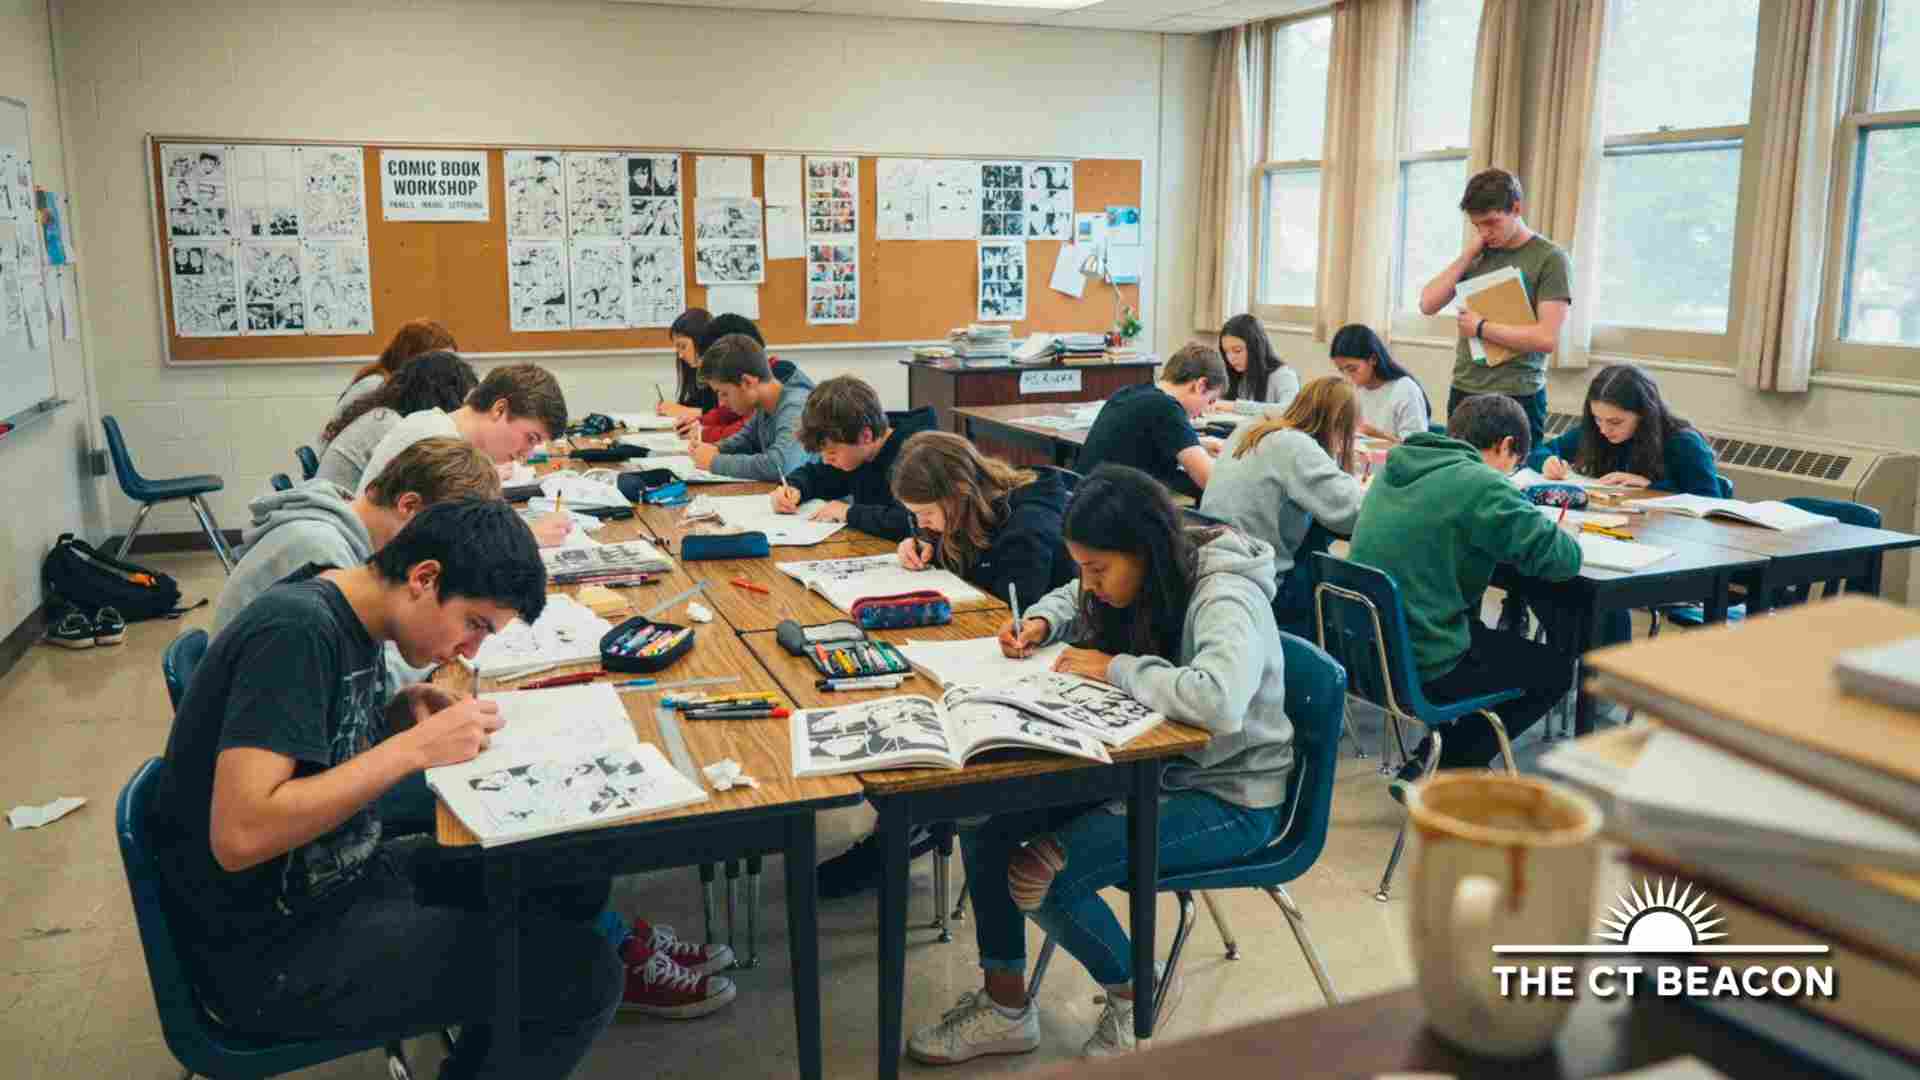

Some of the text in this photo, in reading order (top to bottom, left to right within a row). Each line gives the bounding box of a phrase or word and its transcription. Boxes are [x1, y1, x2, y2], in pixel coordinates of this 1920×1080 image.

[388, 160, 480, 176] COMIC BOOK
[394, 180, 477, 196] WORKSHOP
